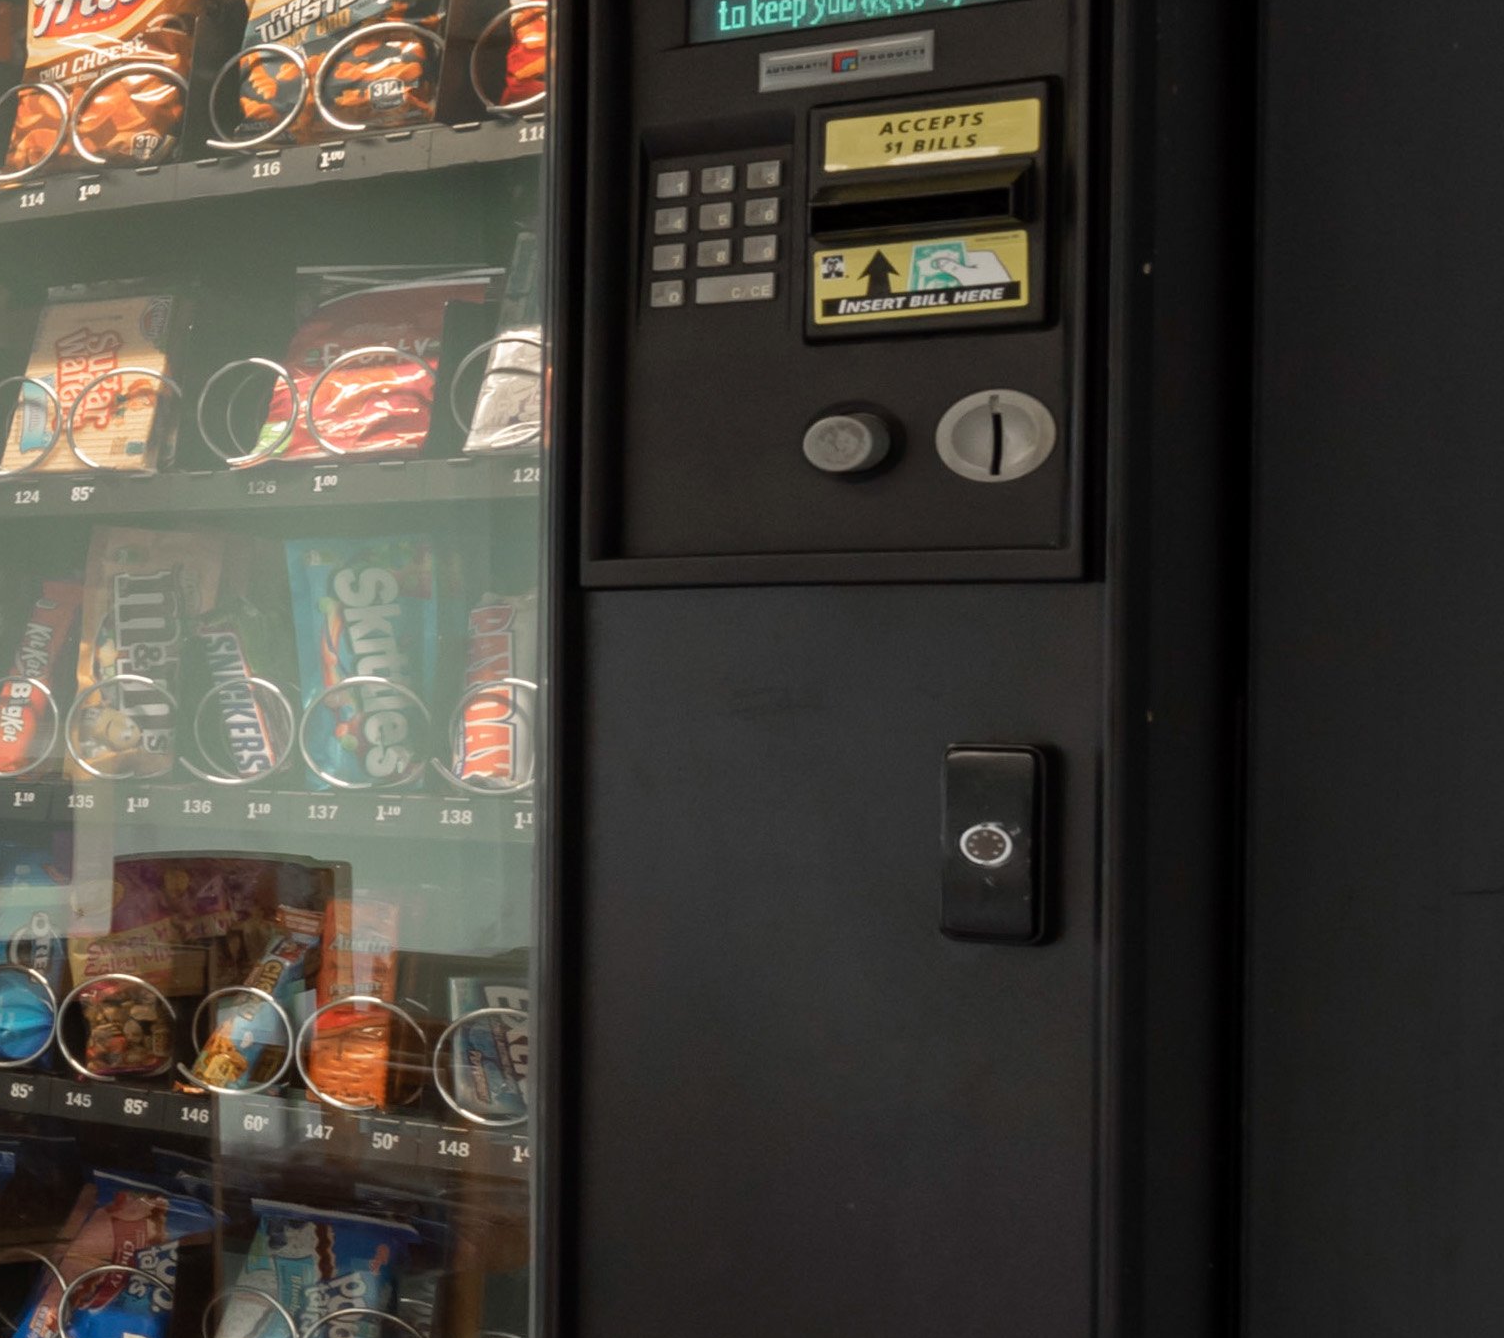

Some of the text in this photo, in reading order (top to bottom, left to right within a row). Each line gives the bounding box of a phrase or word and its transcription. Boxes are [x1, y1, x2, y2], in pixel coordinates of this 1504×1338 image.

[718, 0, 746, 32] to
[39, 33, 149, 84] CHILI CHEESE
[879, 111, 985, 136] ACCEPTS
[884, 133, 978, 154] $1 BILLS
[252, 161, 281, 178] 116
[20, 192, 45, 208] 114
[838, 286, 1005, 315] INSERT BILL HERE
[87, 330, 123, 430] Sugar
[247, 481, 277, 495] 126
[13, 489, 40, 505] 124
[333, 567, 415, 778] Skittles
[204, 633, 267, 776] SNICKERS
[68, 795, 94, 809] 135
[183, 799, 212, 814] 136
[307, 805, 338, 820] 137
[439, 809, 473, 825] 138
[65, 1091, 92, 1108] 145
[180, 1107, 210, 1124] 146
[304, 1123, 334, 1141] 147
[437, 1139, 471, 1158] 148
